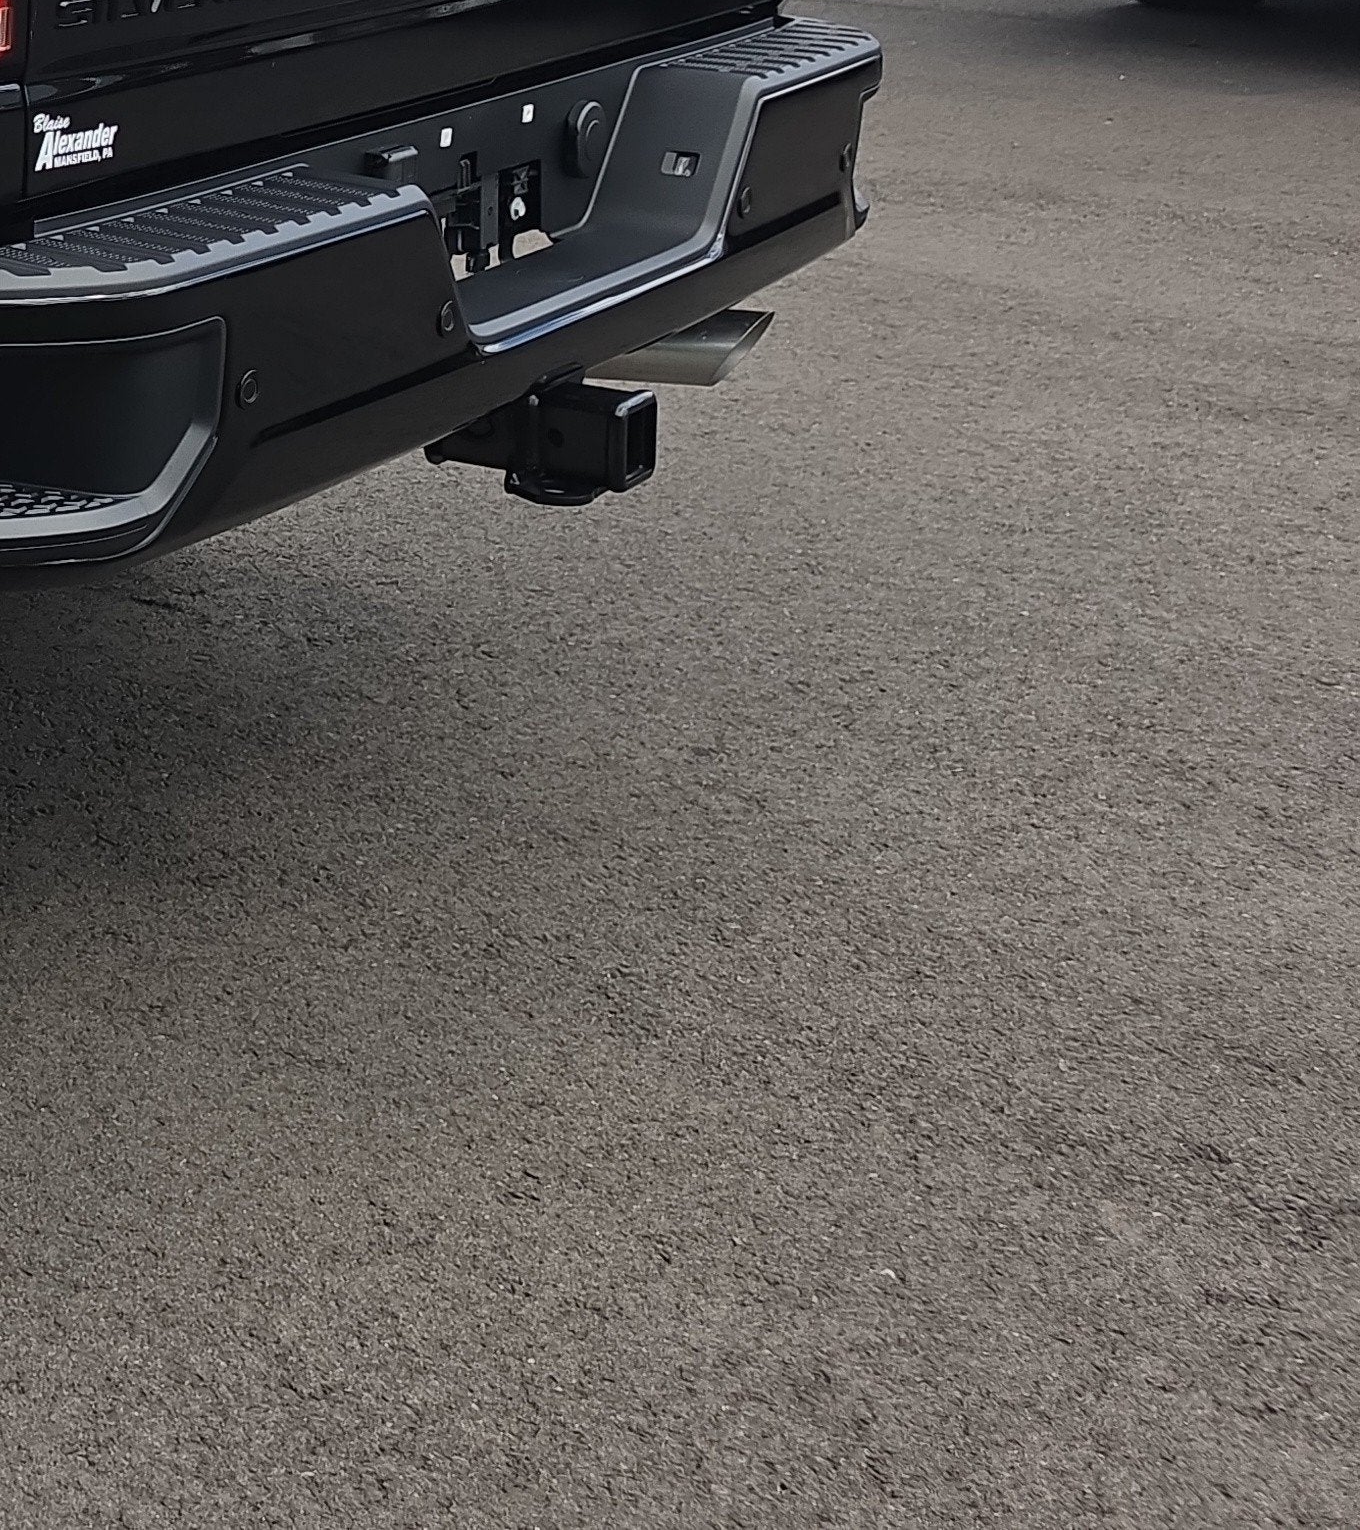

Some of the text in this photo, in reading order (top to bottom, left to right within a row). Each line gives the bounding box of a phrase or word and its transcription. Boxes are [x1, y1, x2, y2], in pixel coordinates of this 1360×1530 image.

[33, 113, 71, 133] Blaise
[35, 123, 118, 171] Alexander
[102, 147, 114, 159] PA
